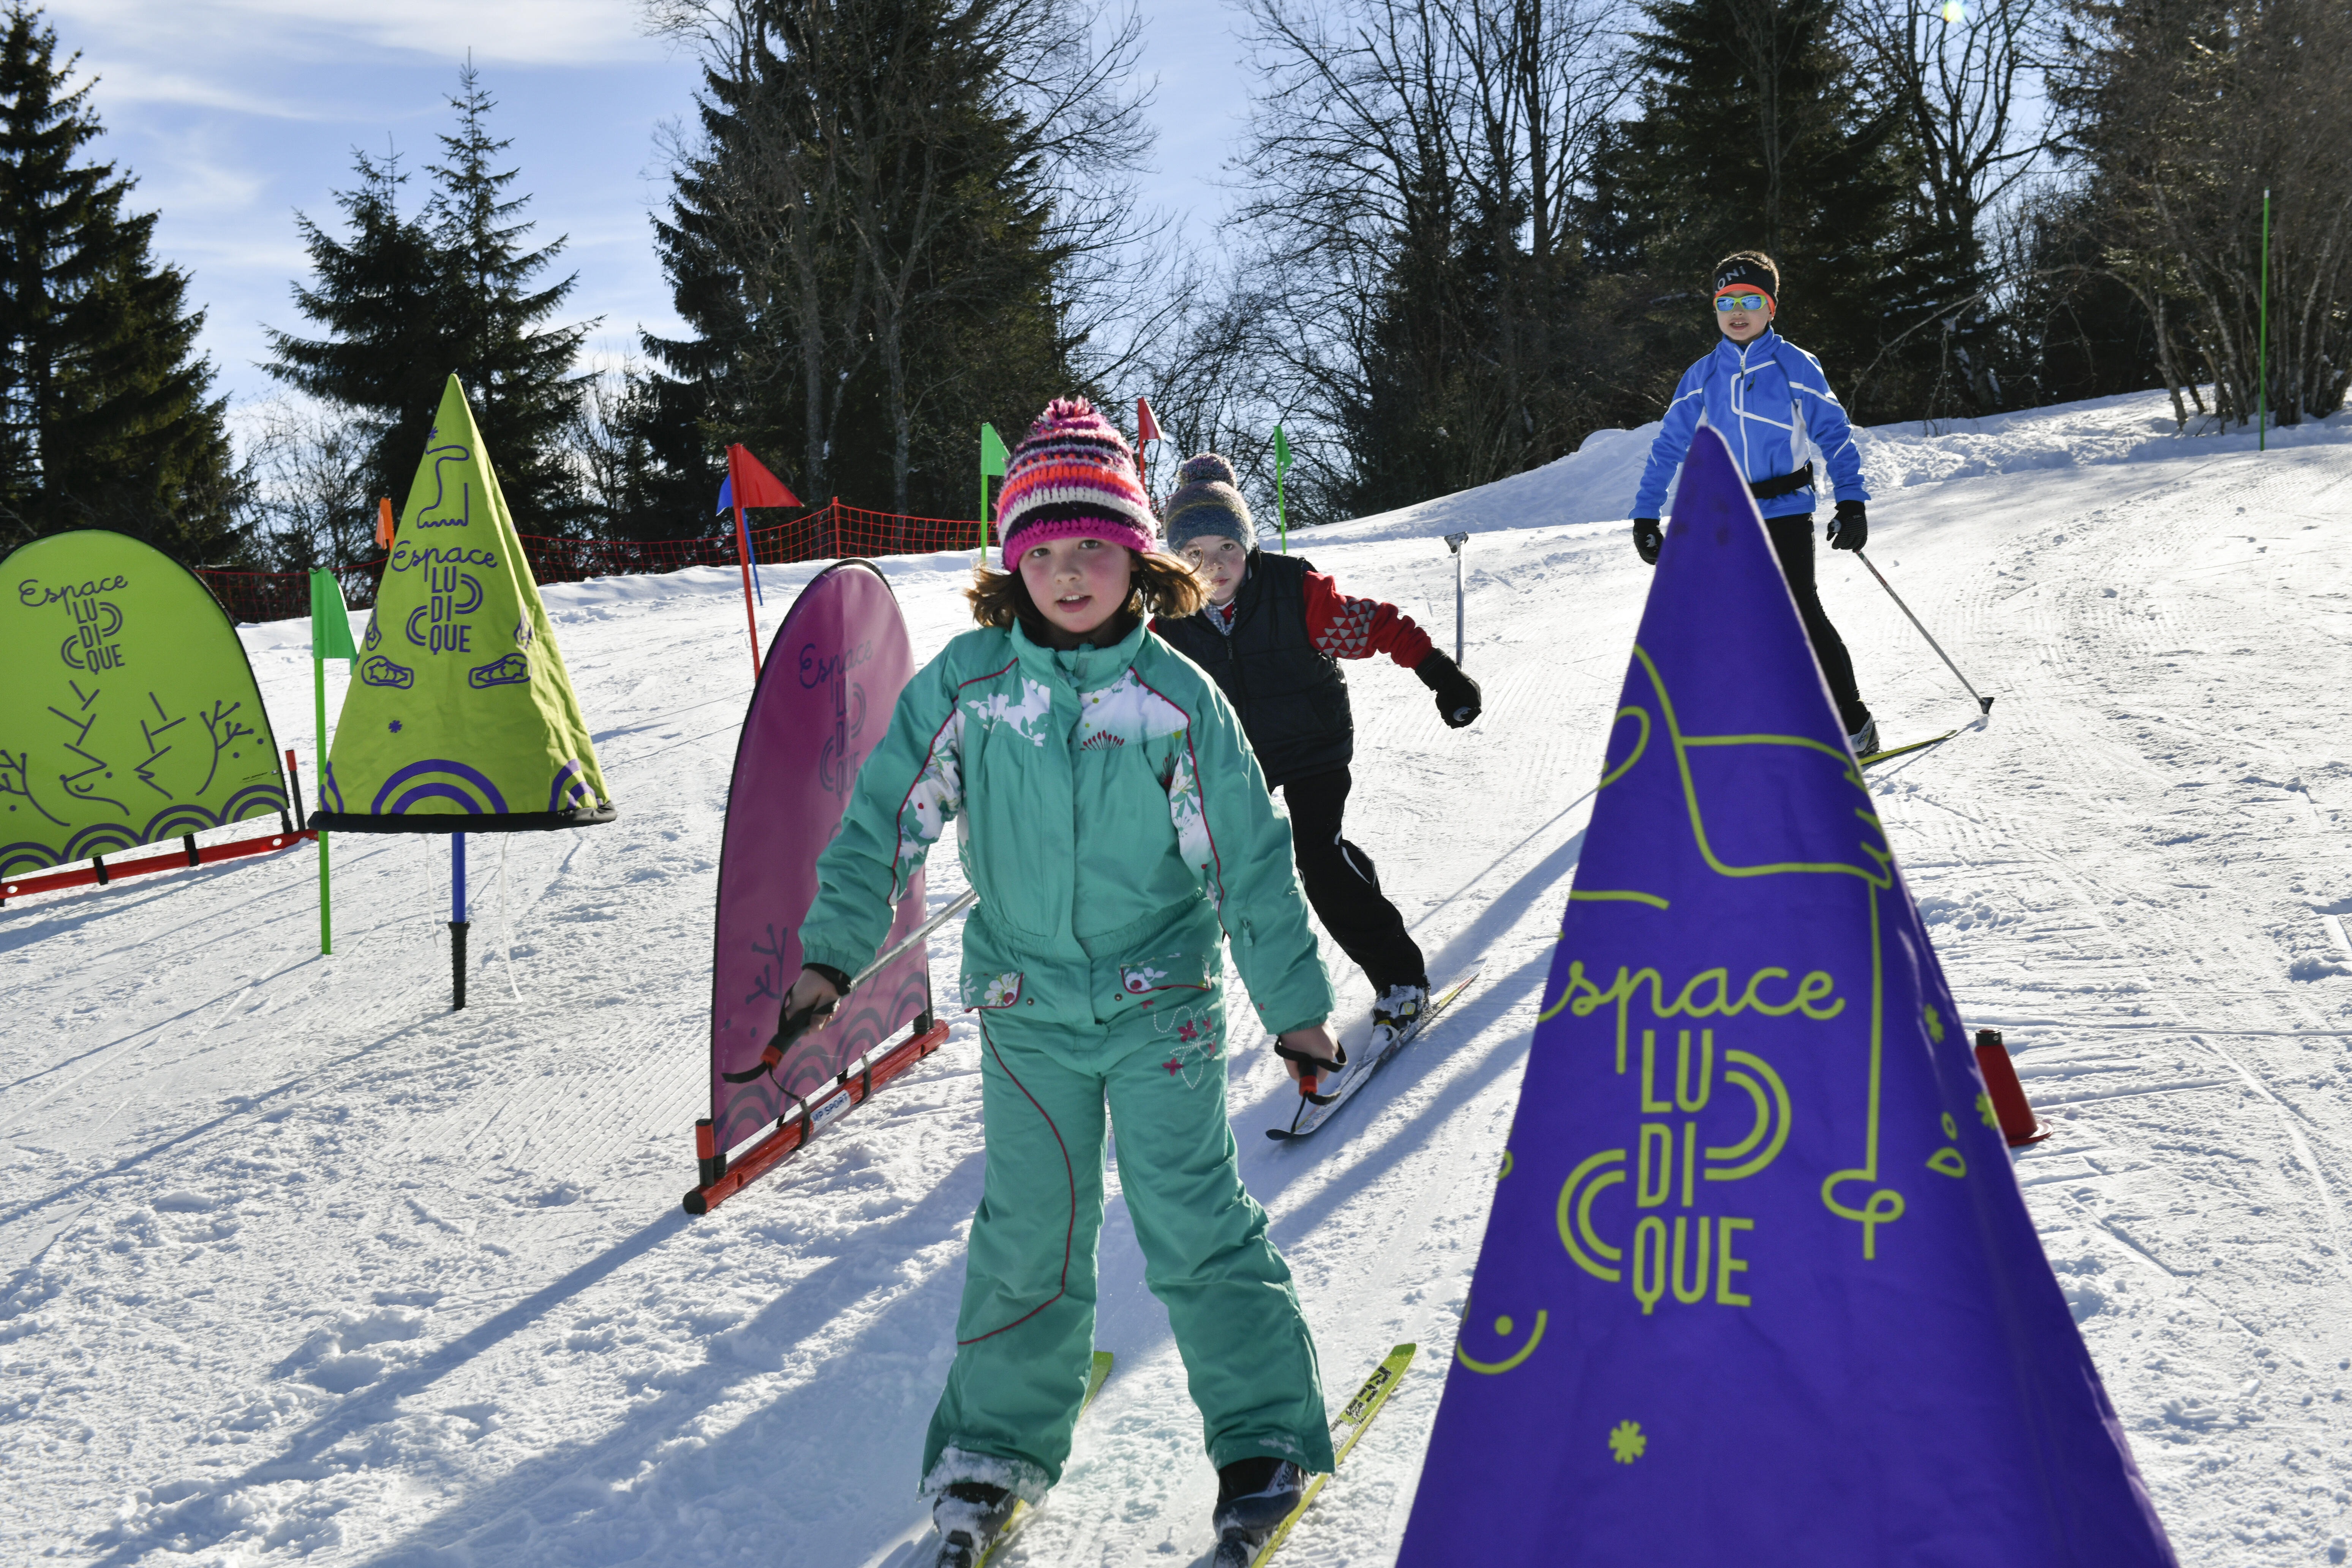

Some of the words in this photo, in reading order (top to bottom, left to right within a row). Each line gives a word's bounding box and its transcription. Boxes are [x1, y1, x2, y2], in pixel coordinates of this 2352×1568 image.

[1715, 266, 1746, 294] ONI
[392, 540, 498, 582] Espace
[18, 575, 128, 615] Espace
[800, 640, 874, 703] Espace
[1536, 960, 1846, 1074] space
[824, 1093, 847, 1115] SPORT
